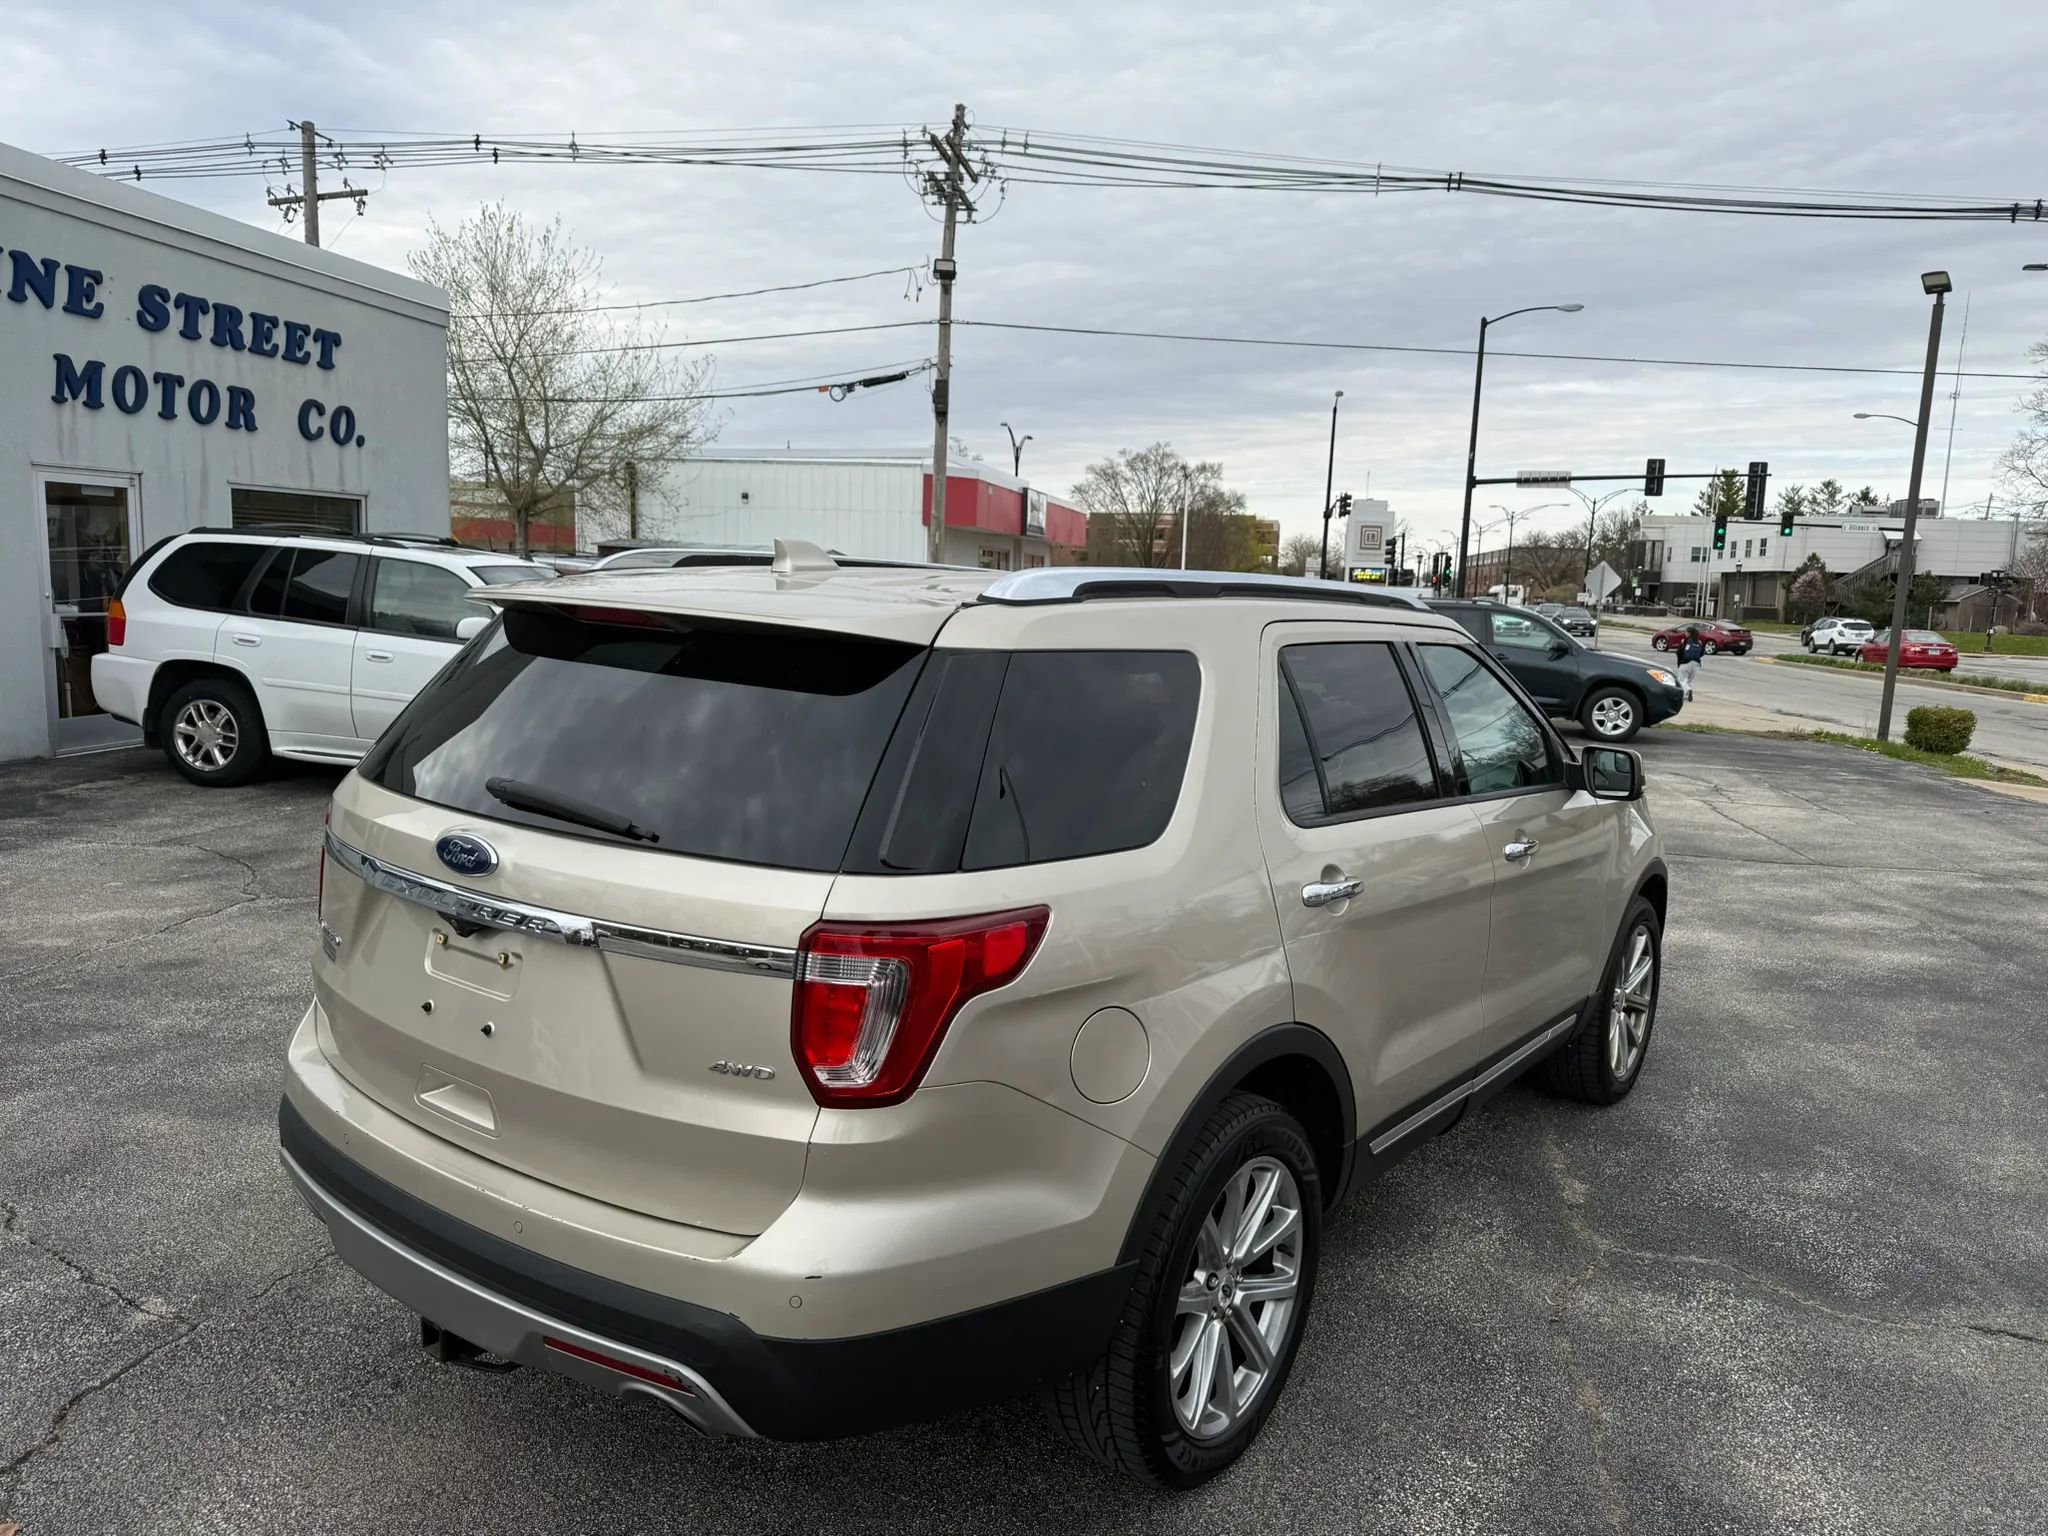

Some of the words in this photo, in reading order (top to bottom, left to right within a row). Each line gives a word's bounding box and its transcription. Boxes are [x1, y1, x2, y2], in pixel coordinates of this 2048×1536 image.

[0, 246, 104, 319] NE
[137, 284, 341, 370] STREET
[51, 353, 258, 432] MOTOR
[298, 399, 366, 448] CO.
[443, 839, 479, 868] Ford
[380, 876, 547, 933] EXPLORER
[708, 1060, 776, 1080] 4WD
